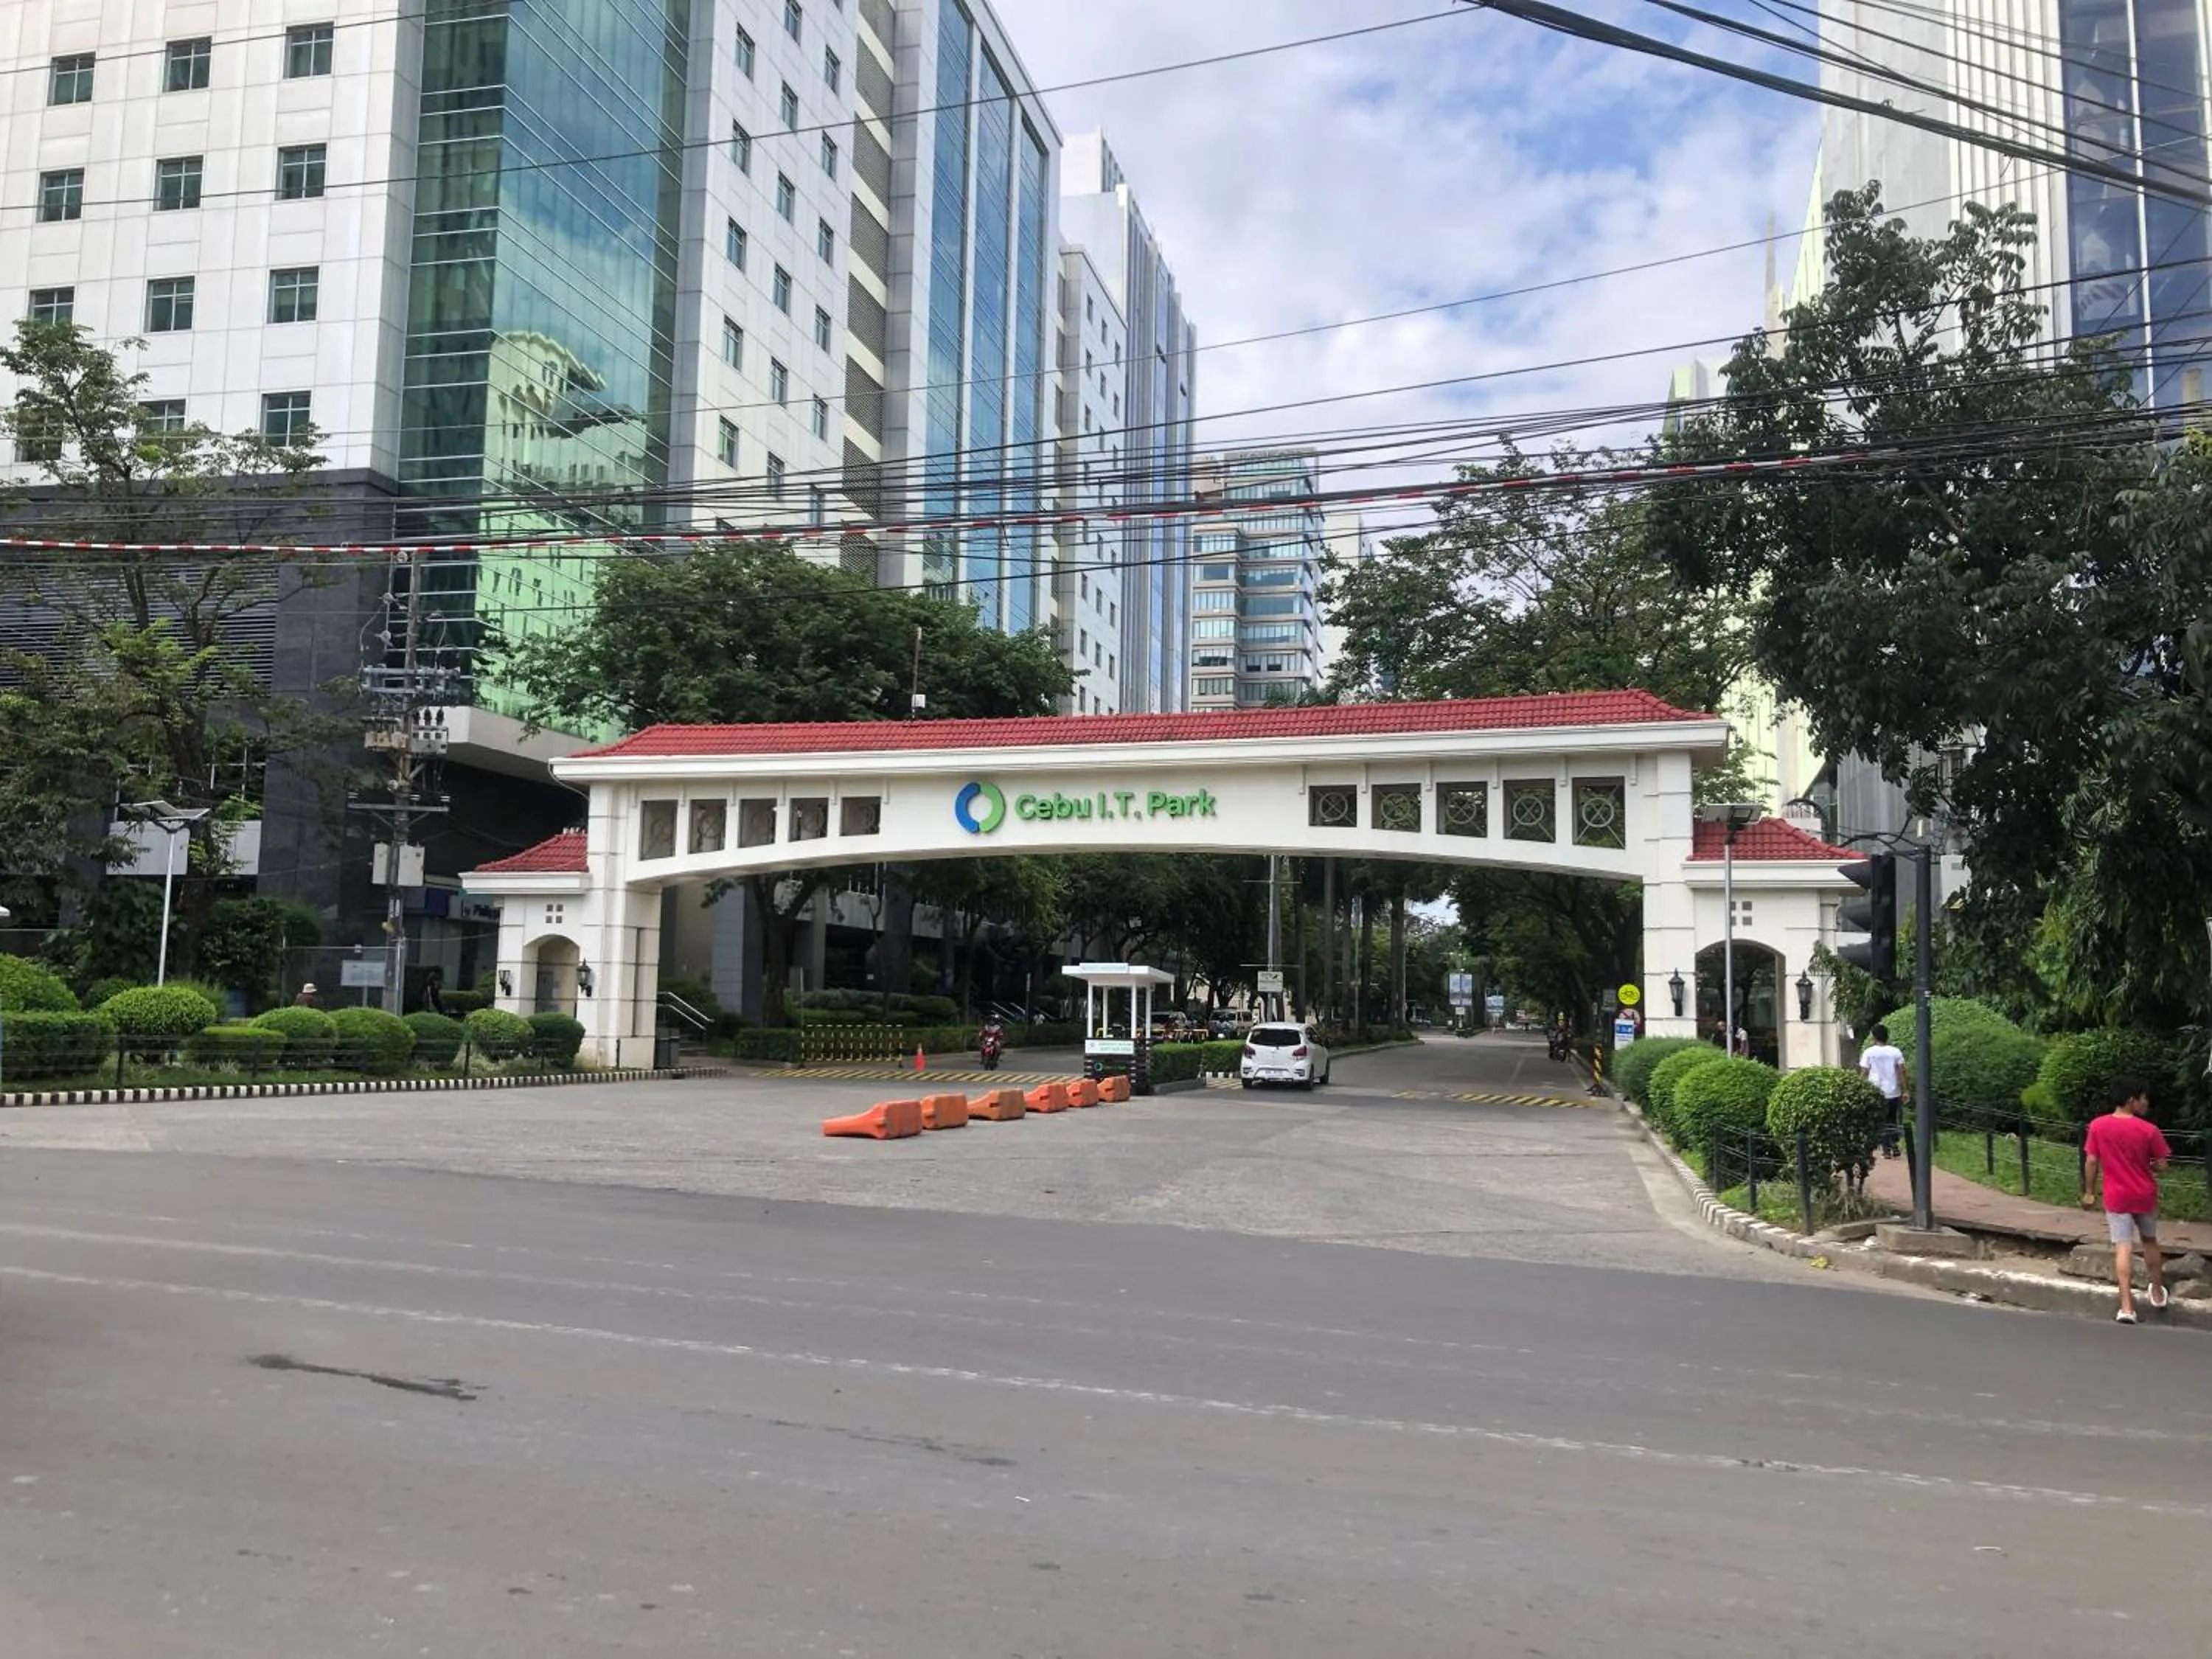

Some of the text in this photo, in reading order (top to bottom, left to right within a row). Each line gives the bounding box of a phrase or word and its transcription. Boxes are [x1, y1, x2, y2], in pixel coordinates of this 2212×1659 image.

[1015, 789, 1216, 820] Cebu I.T. Park
